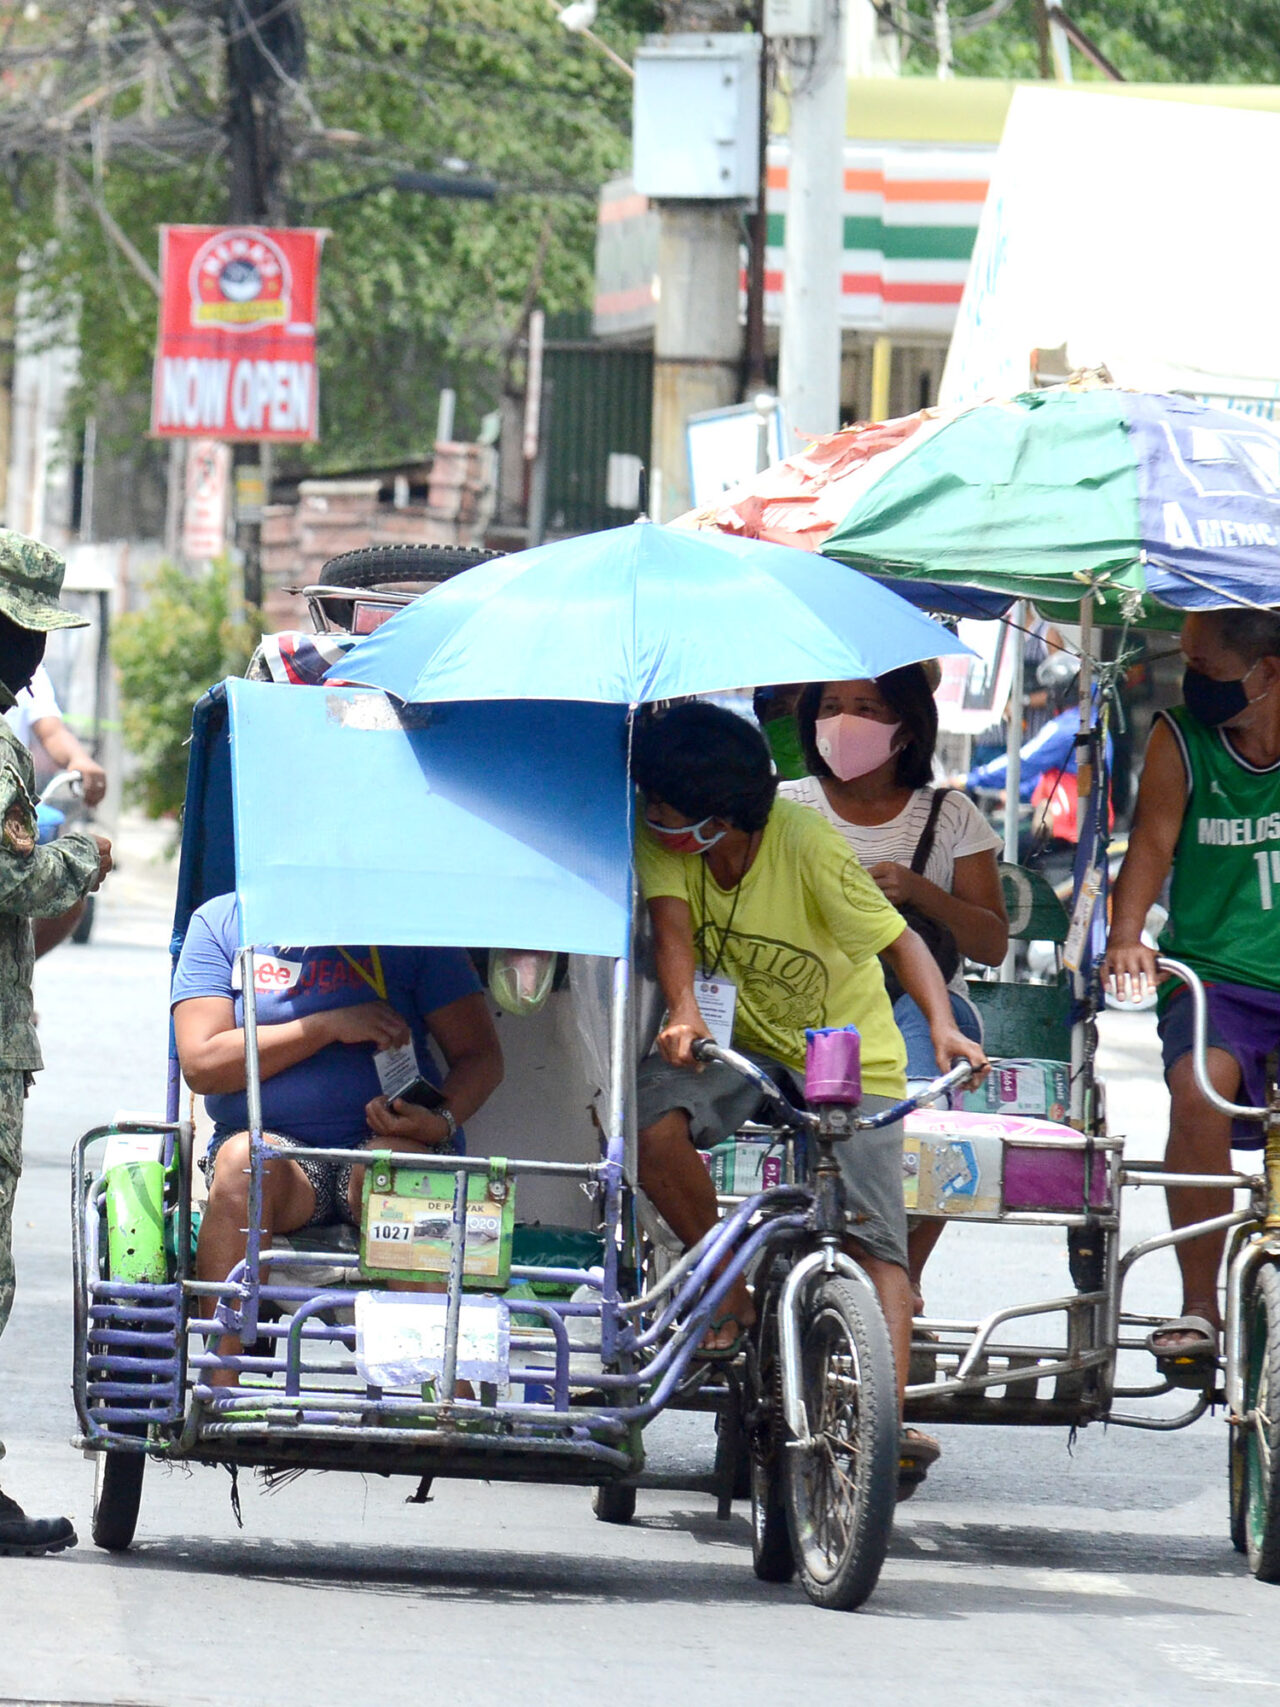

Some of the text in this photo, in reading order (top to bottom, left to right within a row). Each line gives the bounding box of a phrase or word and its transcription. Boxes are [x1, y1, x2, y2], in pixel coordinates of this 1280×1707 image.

[160, 356, 314, 432] NOW OPEN
[246, 962, 291, 985] ee
[714, 934, 822, 995] CTION
[428, 1202, 441, 1210] DE
[374, 1225, 410, 1241] 1027
